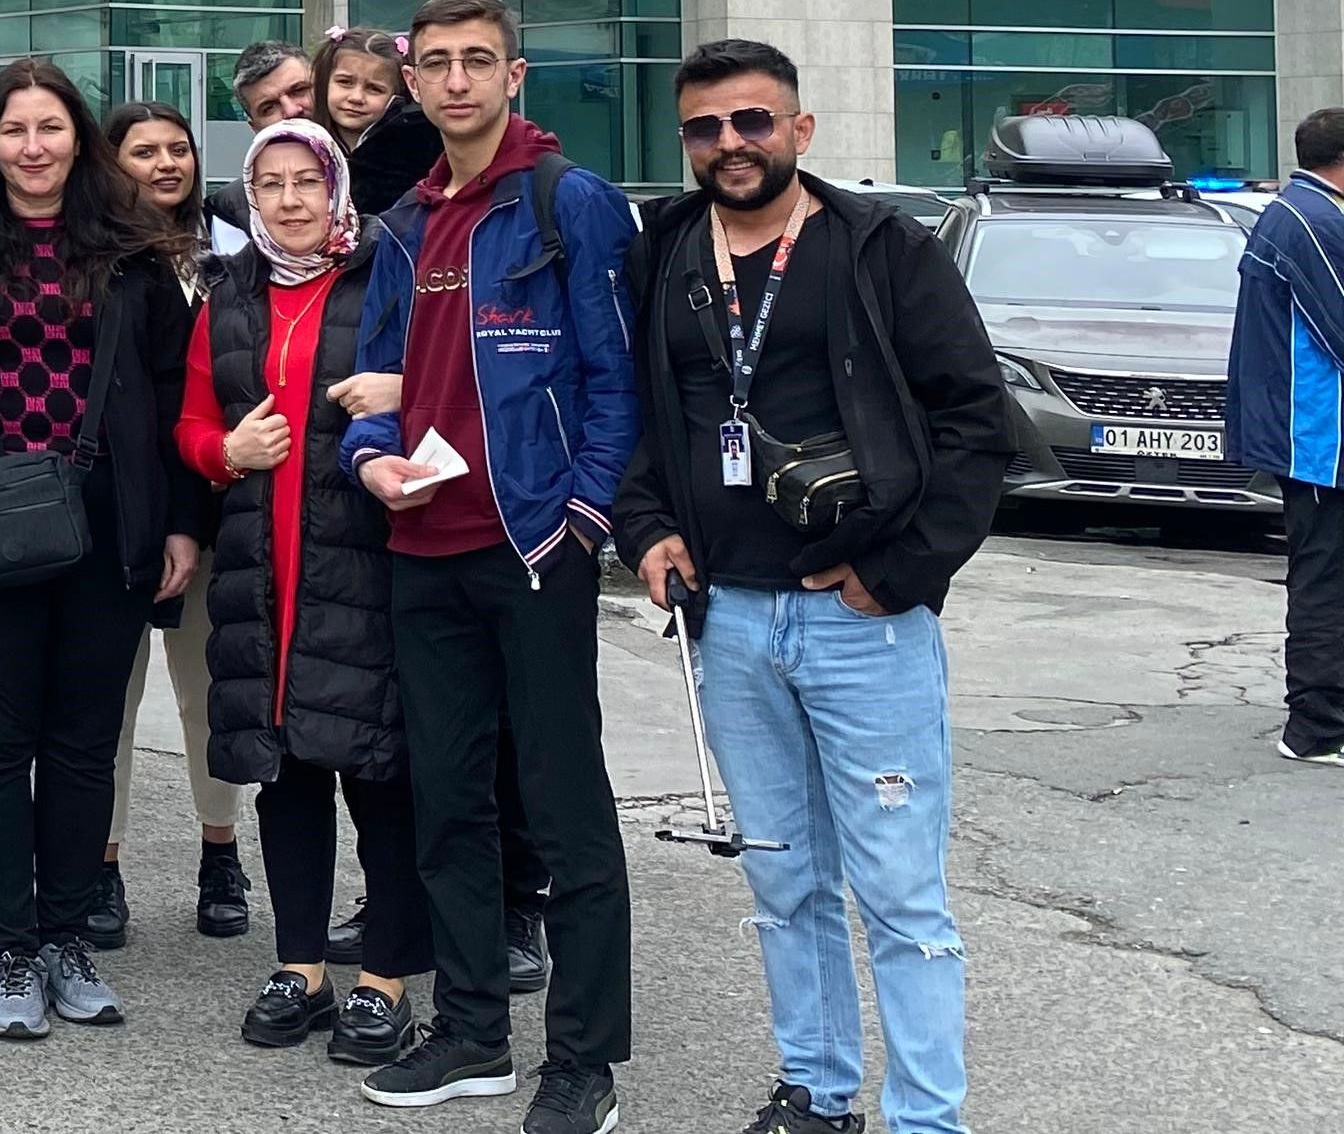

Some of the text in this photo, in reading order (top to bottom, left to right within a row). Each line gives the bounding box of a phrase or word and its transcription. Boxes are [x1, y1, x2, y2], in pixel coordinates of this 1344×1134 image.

[476, 329, 508, 339] ROYAL
[508, 328, 539, 337] YACHT
[1105, 429, 1219, 452] 01 AHY 203
